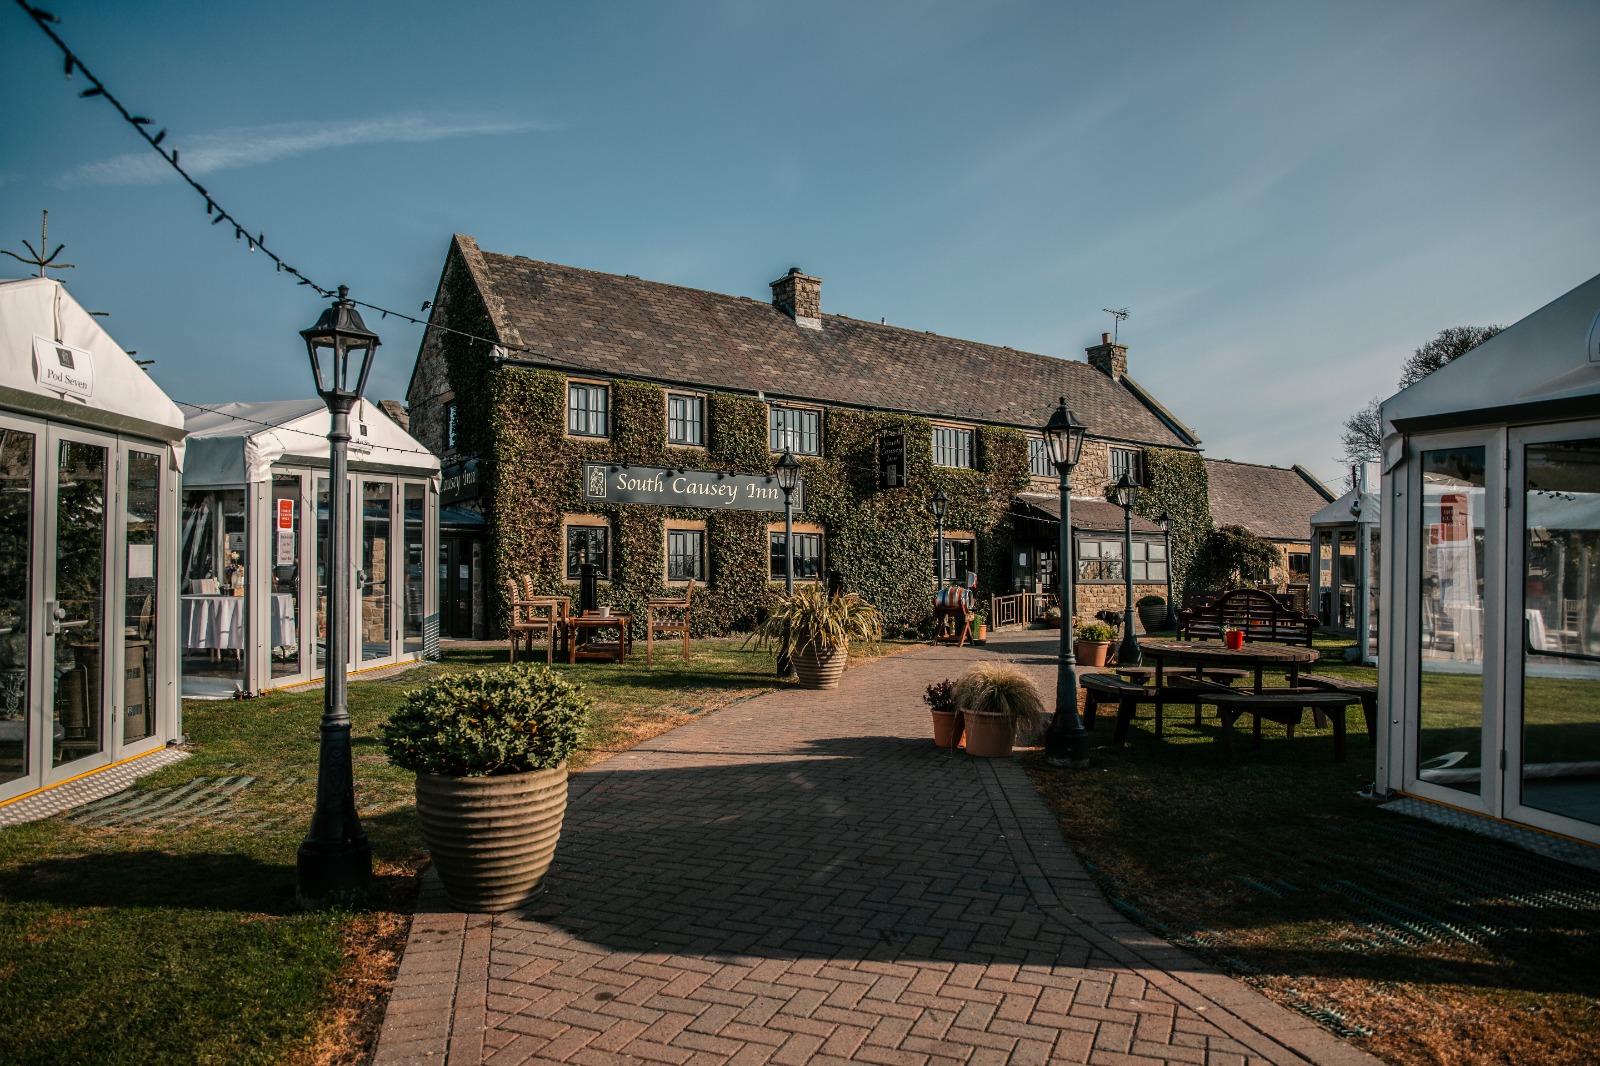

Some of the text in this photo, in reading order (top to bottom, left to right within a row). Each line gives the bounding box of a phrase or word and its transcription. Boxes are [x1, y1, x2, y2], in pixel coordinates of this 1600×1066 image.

[47, 368, 88, 389] Pod Seven
[462, 470, 476, 486] Inn
[616, 472, 779, 505] South Causey Inn
